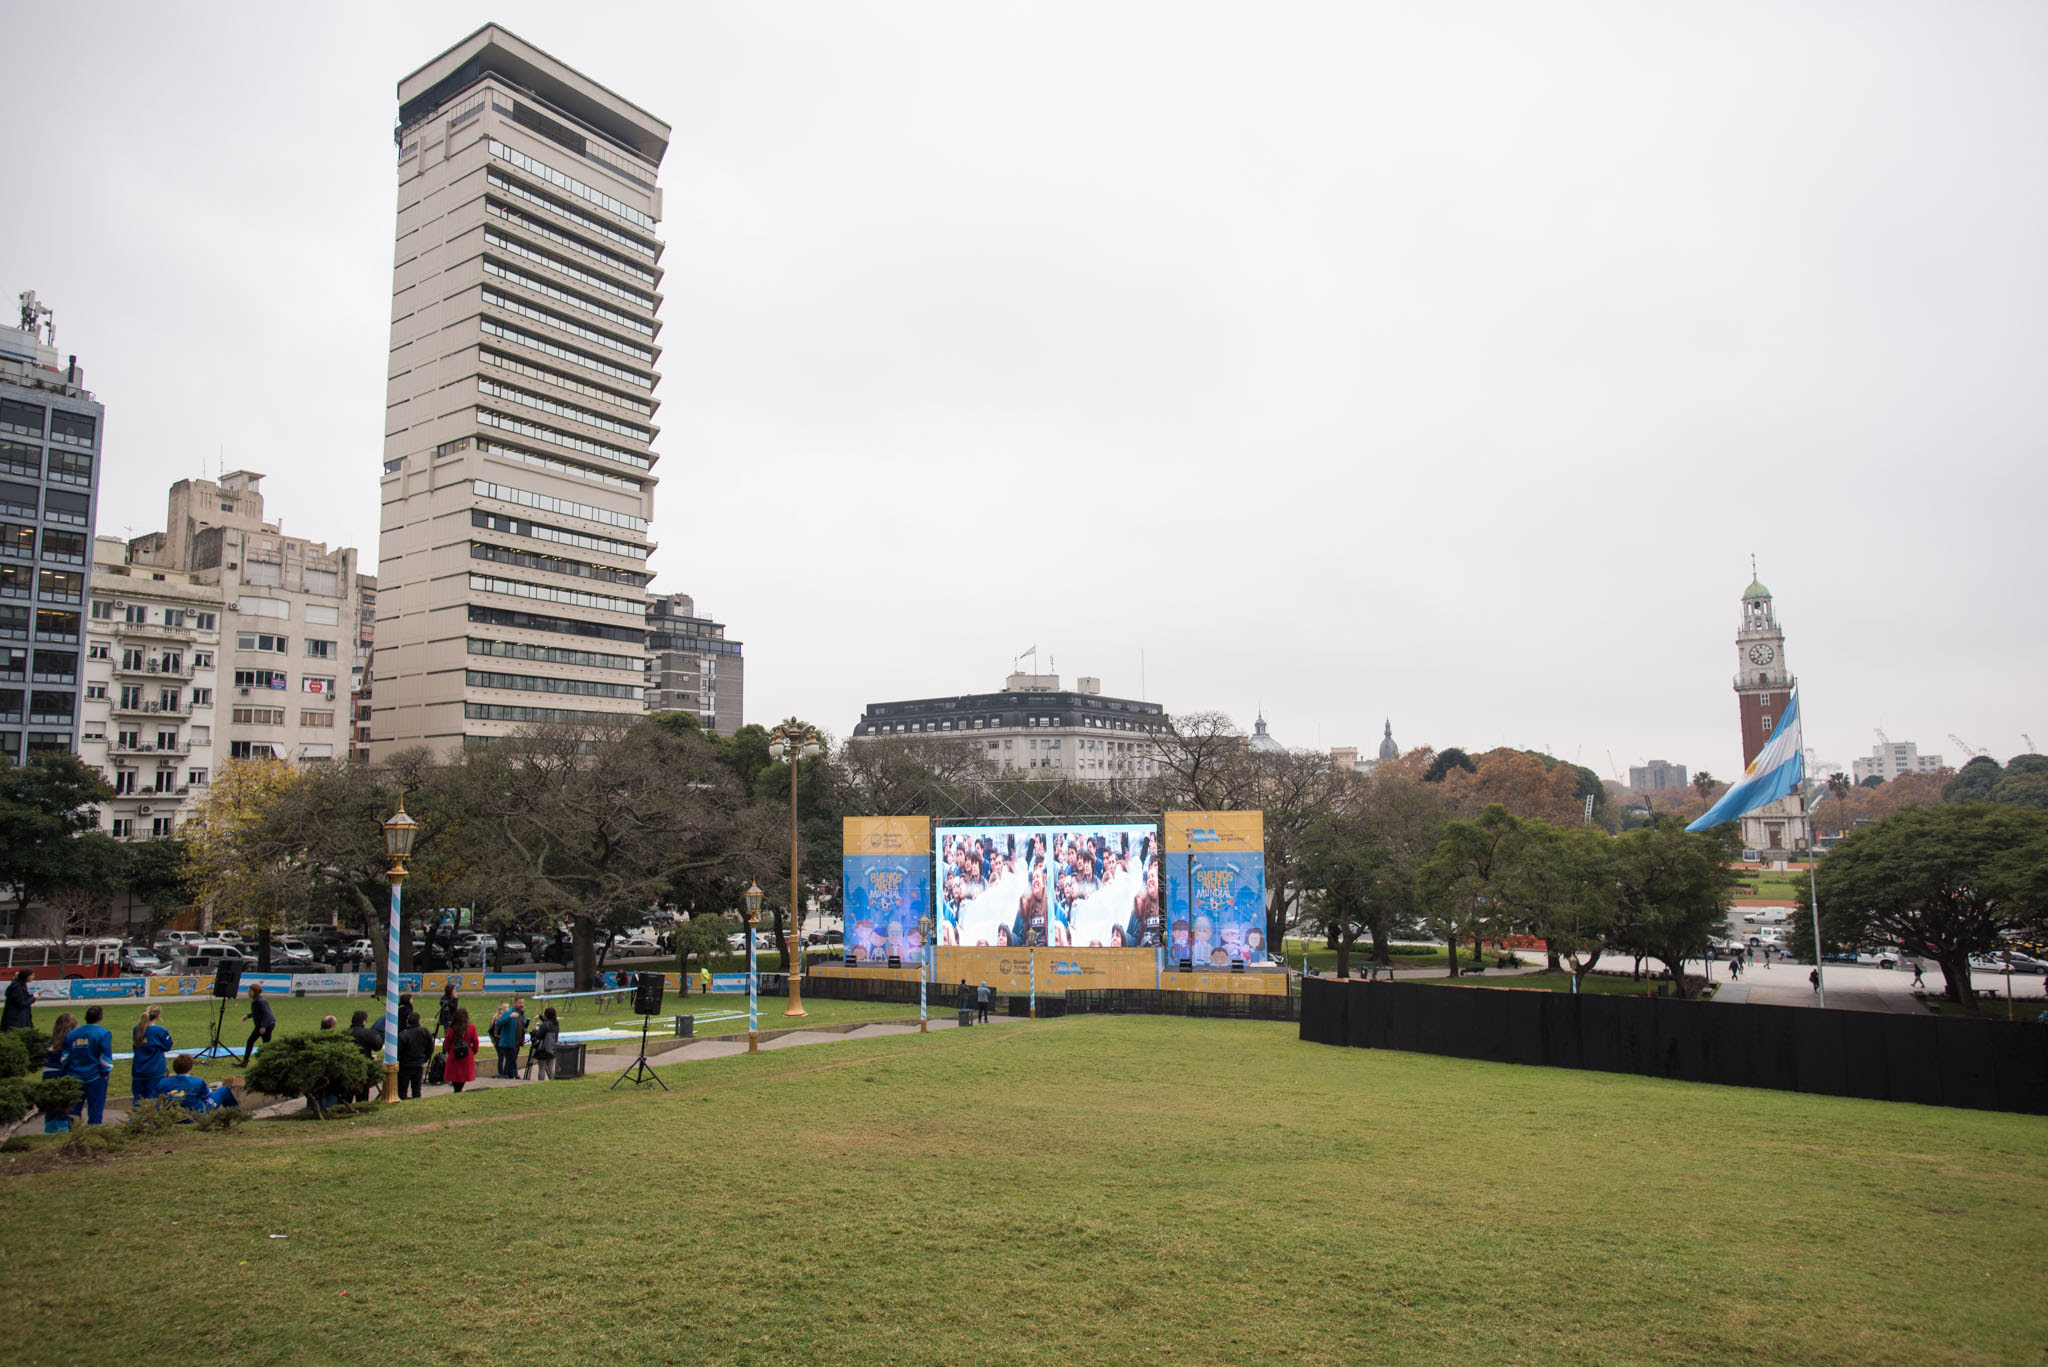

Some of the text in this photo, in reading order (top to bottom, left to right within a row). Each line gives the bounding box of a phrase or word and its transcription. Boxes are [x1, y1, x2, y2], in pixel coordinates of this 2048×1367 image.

[870, 871, 903, 882] BUENOS
[1197, 870, 1234, 881] BUENOS
[874, 879, 898, 890] AIRES
[1202, 879, 1229, 889] AIRES
[870, 889, 903, 900] MUNDIAL
[1197, 888, 1233, 899] MUNDIAL
